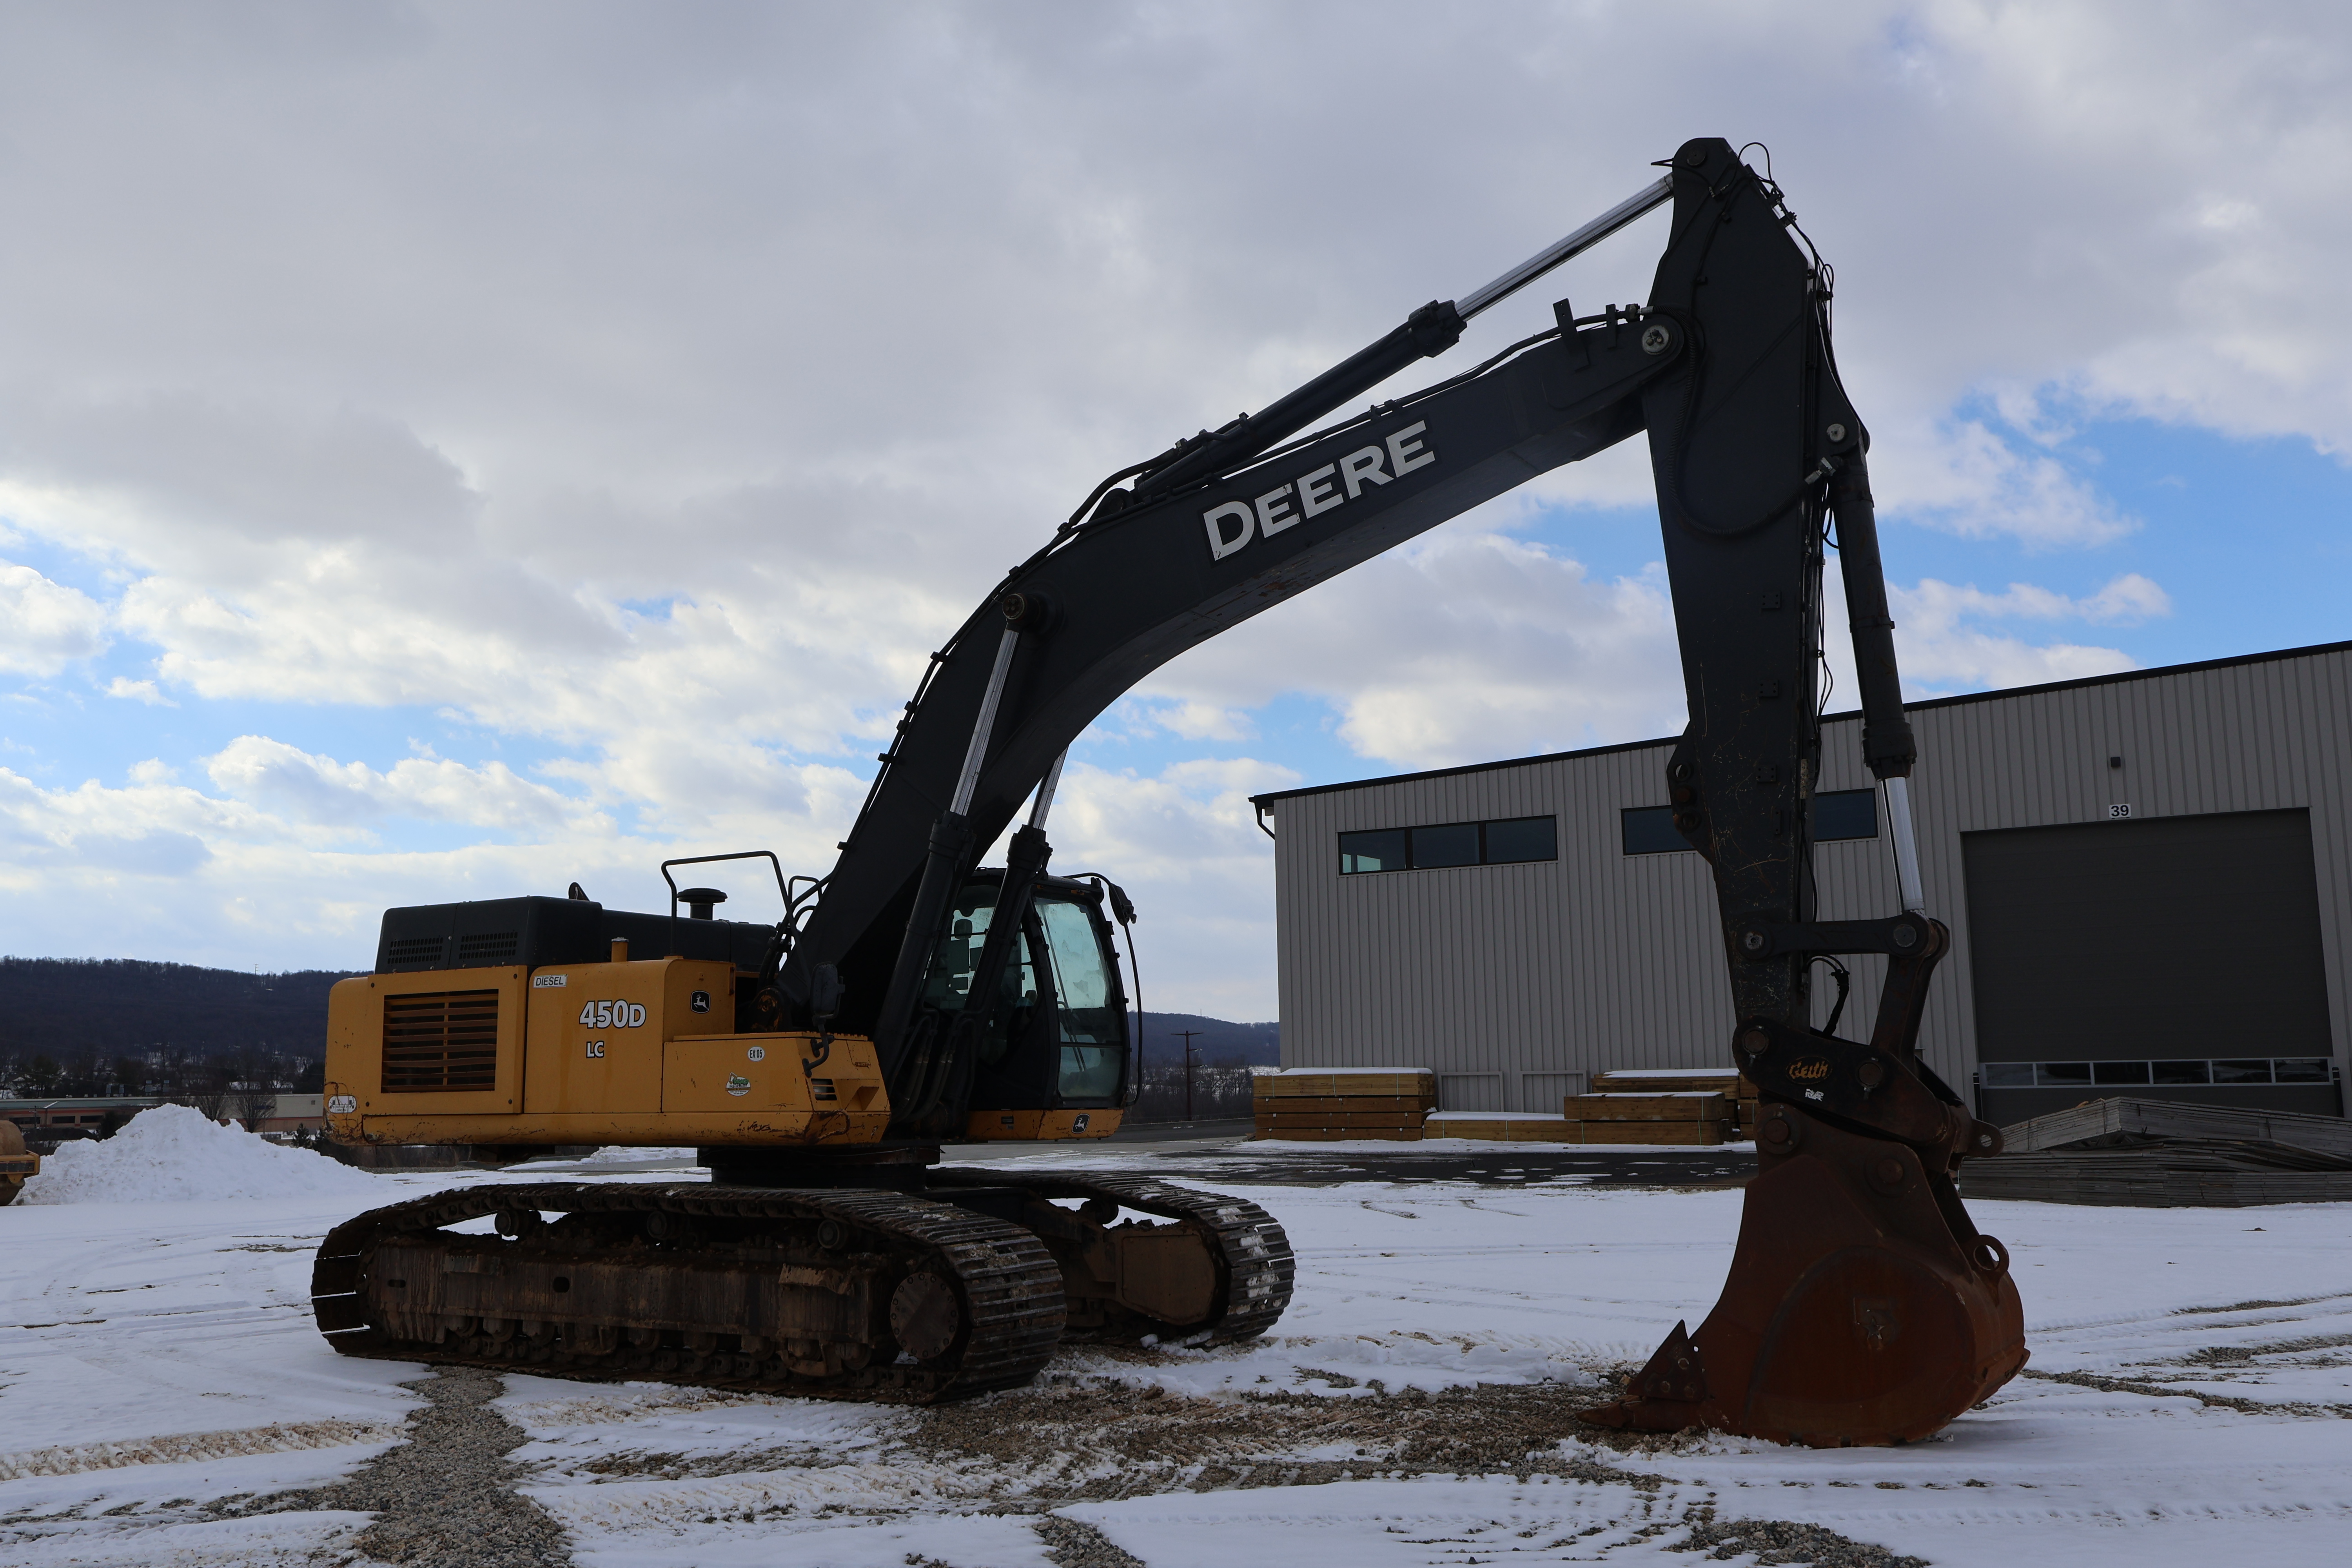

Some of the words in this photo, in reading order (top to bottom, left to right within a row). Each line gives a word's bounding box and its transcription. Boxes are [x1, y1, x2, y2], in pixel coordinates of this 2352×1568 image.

[1203, 420, 1436, 561] DEERE
[2111, 805, 2129, 817] 39
[535, 976, 563, 986] DIESEL
[579, 999, 646, 1029] 450D
[586, 1040, 604, 1058] LC
[750, 1049, 755, 1058] EX
[757, 1049, 762, 1058] 05
